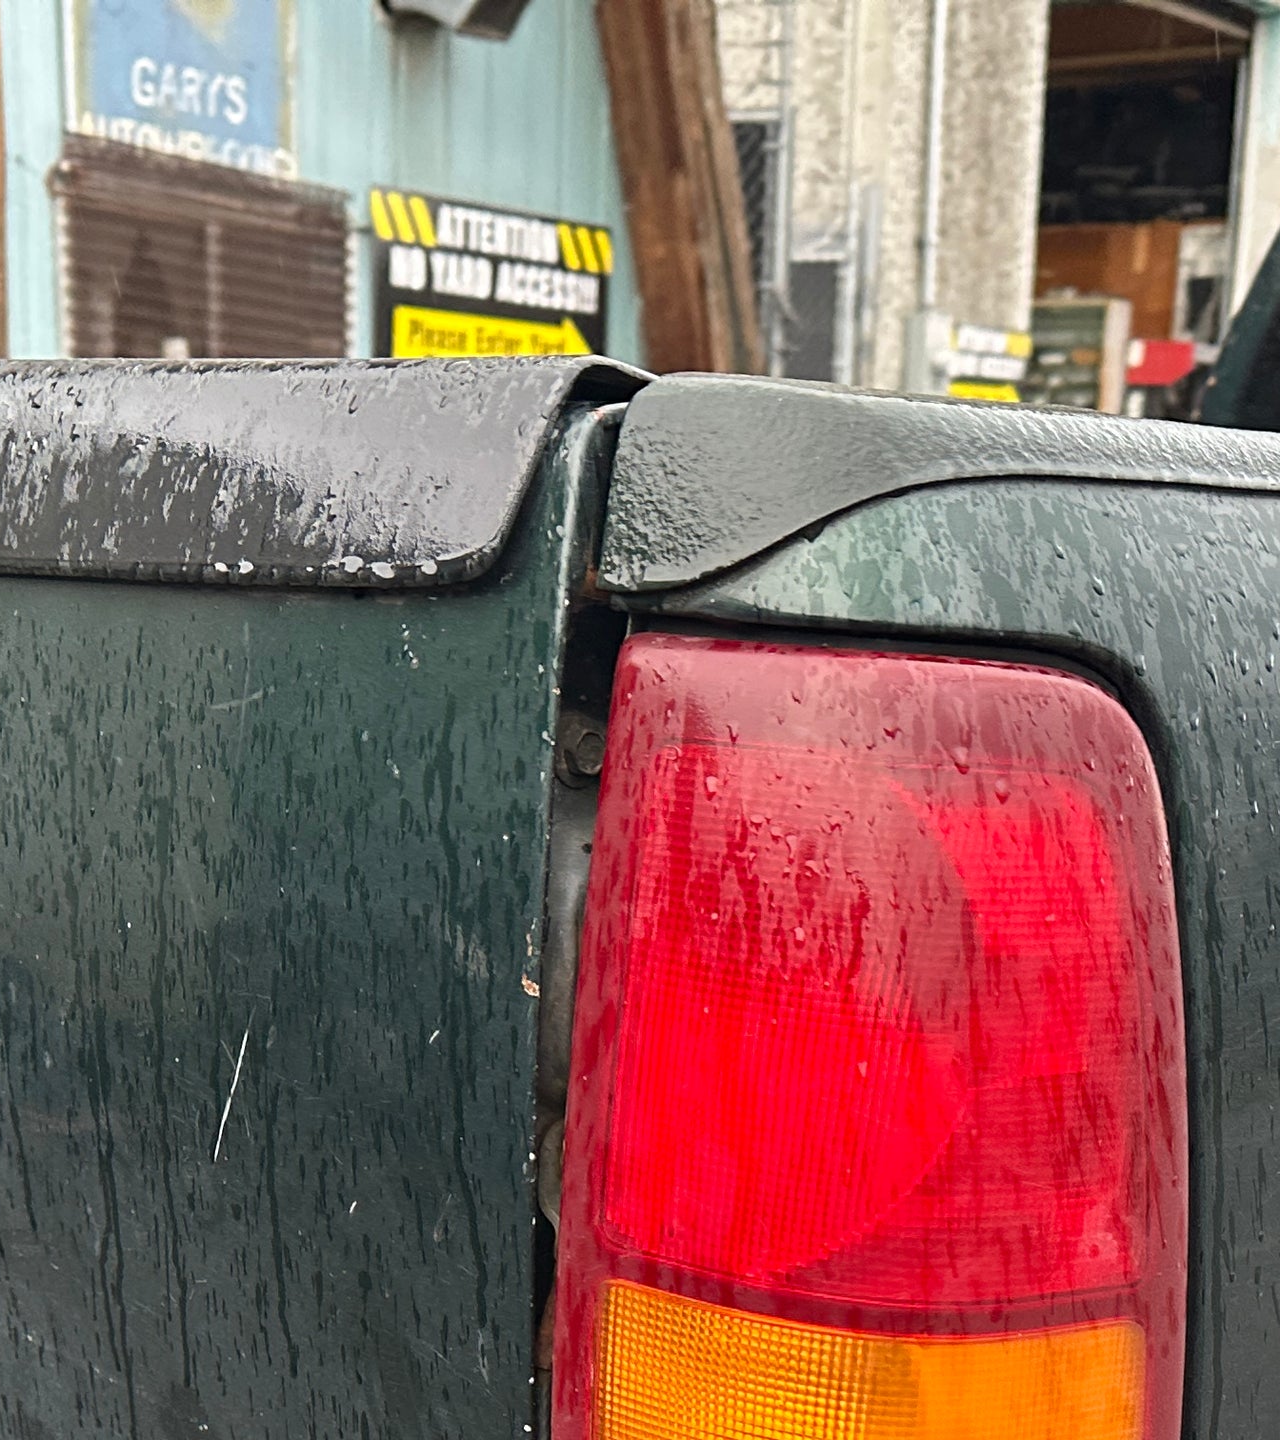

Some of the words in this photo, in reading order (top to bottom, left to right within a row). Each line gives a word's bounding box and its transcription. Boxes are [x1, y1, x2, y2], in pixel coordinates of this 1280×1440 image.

[437, 203, 560, 265] ATTENTION
[389, 245, 427, 291] NO
[429, 251, 493, 299] YARD
[407, 317, 468, 351] Please
